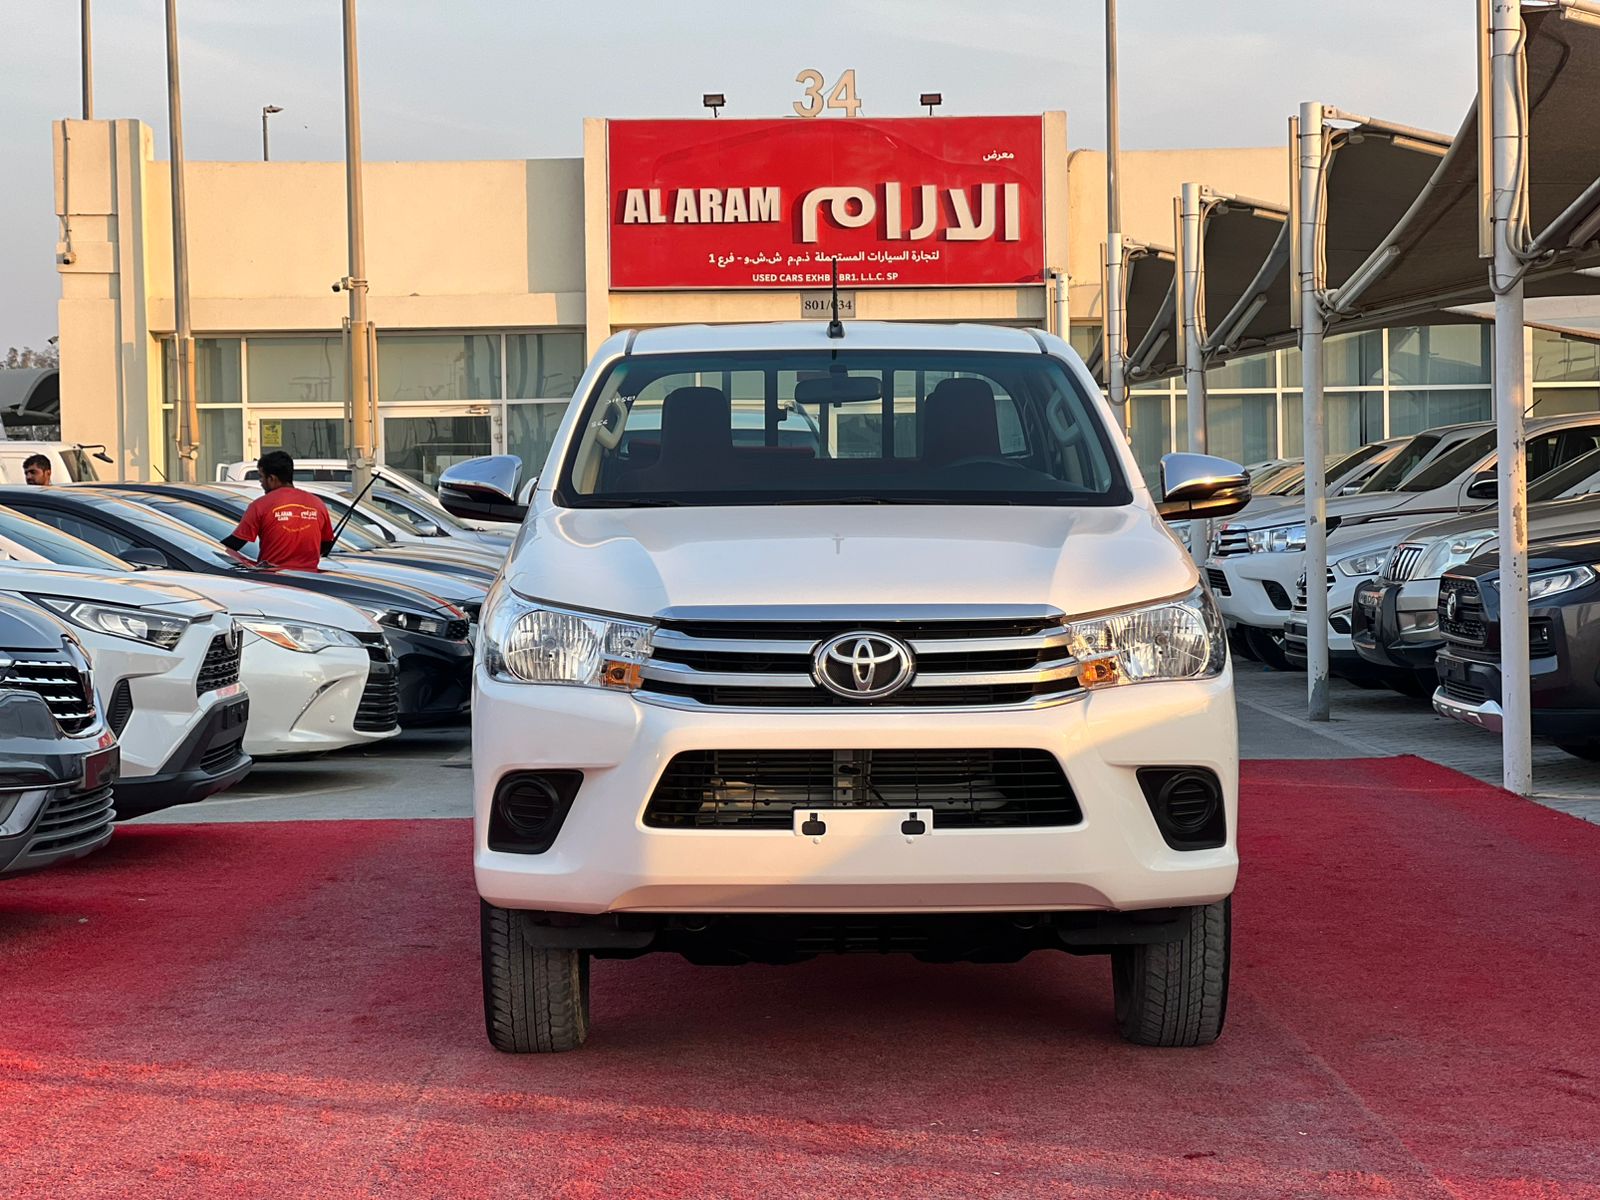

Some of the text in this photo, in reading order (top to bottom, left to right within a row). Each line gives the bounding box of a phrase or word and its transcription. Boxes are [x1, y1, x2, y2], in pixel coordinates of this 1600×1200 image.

[793, 69, 861, 118] 34
[983, 150, 1014, 161] معرض
[623, 187, 781, 223] AL ARAM
[709, 253, 715, 263] 1
[717, 252, 735, 268] فرع
[814, 251, 865, 262] المستعملة
[867, 250, 909, 263] السيارات
[911, 250, 939, 262] لتجارة
[752, 274, 777, 282] USED
[779, 274, 803, 282] CARS
[886, 272, 898, 280] SP
